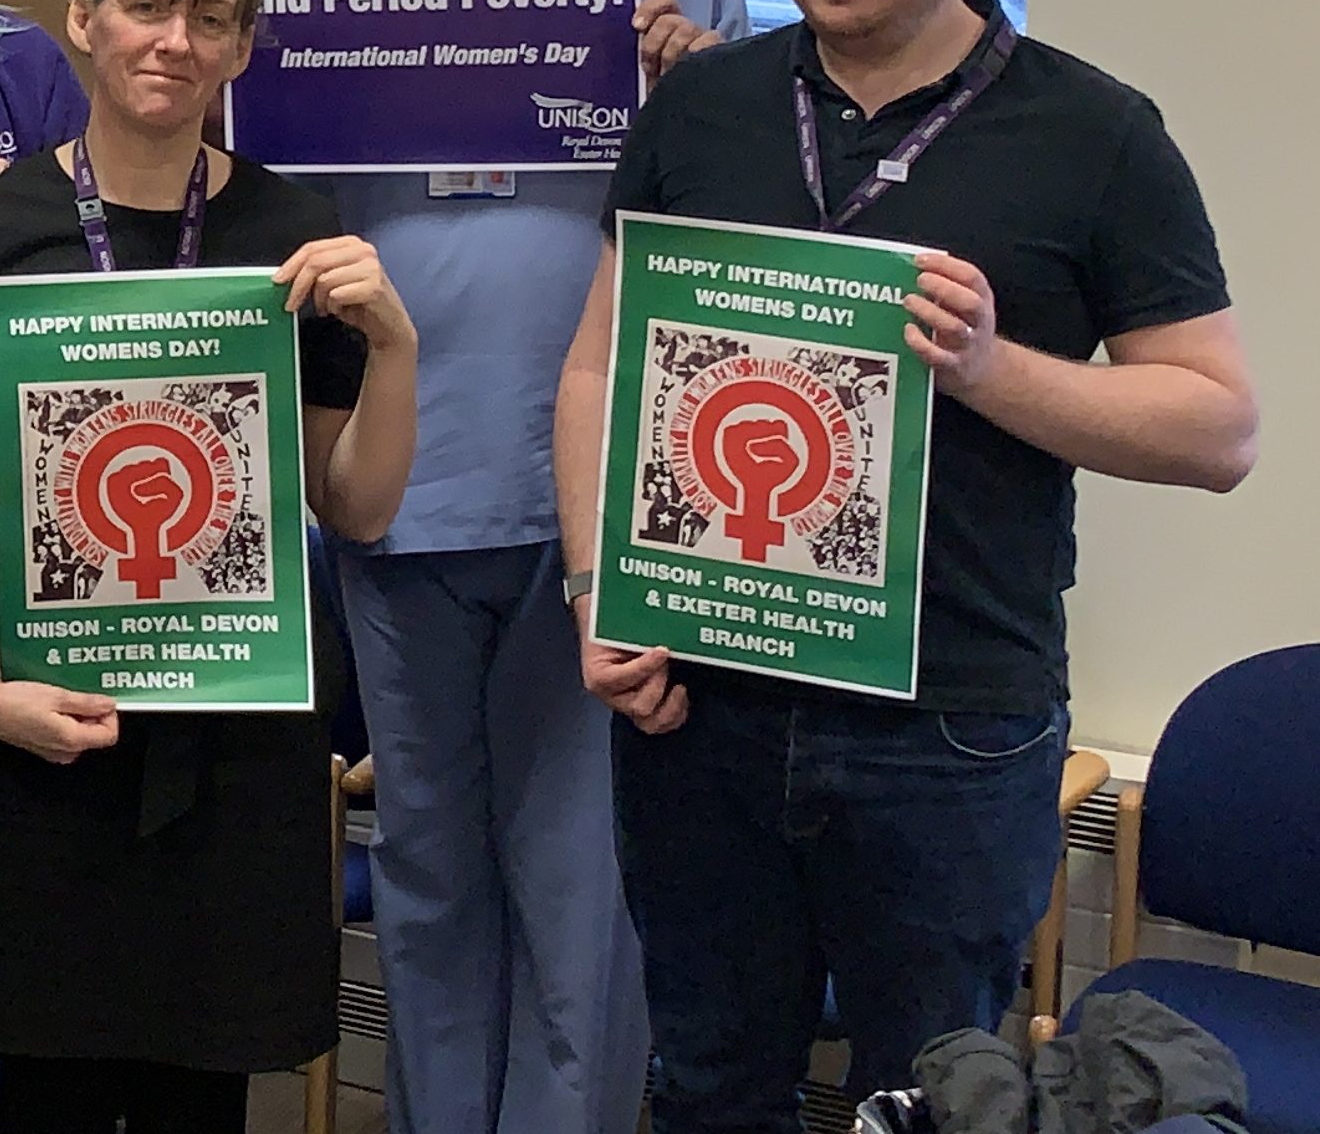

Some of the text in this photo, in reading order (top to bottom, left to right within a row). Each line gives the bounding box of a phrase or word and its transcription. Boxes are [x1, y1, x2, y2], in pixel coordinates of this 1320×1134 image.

[281, 43, 590, 67] International Women's Day
[539, 107, 629, 128] UNISON
[648, 255, 905, 306] HAPPY INTERNATIONAL
[10, 309, 268, 335] HAPPY INTERNATIONAL
[695, 289, 853, 326] WOMENS DAY!
[61, 339, 219, 361] WOMENS DAY!
[651, 377, 674, 459] WOMEN
[855, 408, 874, 491] UNITE
[36, 439, 54, 521] WOMEN
[229, 430, 253, 510] UNITE
[620, 557, 702, 586] UNISON
[724, 576, 799, 603] ROYAL
[807, 589, 886, 617] DEVON
[17, 620, 99, 638] UNISON
[122, 616, 194, 633] ROYAL
[202, 615, 278, 632] DEVON
[646, 590, 854, 640] & EXETER HEALTH
[47, 644, 250, 664] & EXETER HEALTH
[700, 627, 794, 657] BRANCH
[102, 672, 195, 690] BRANCH
